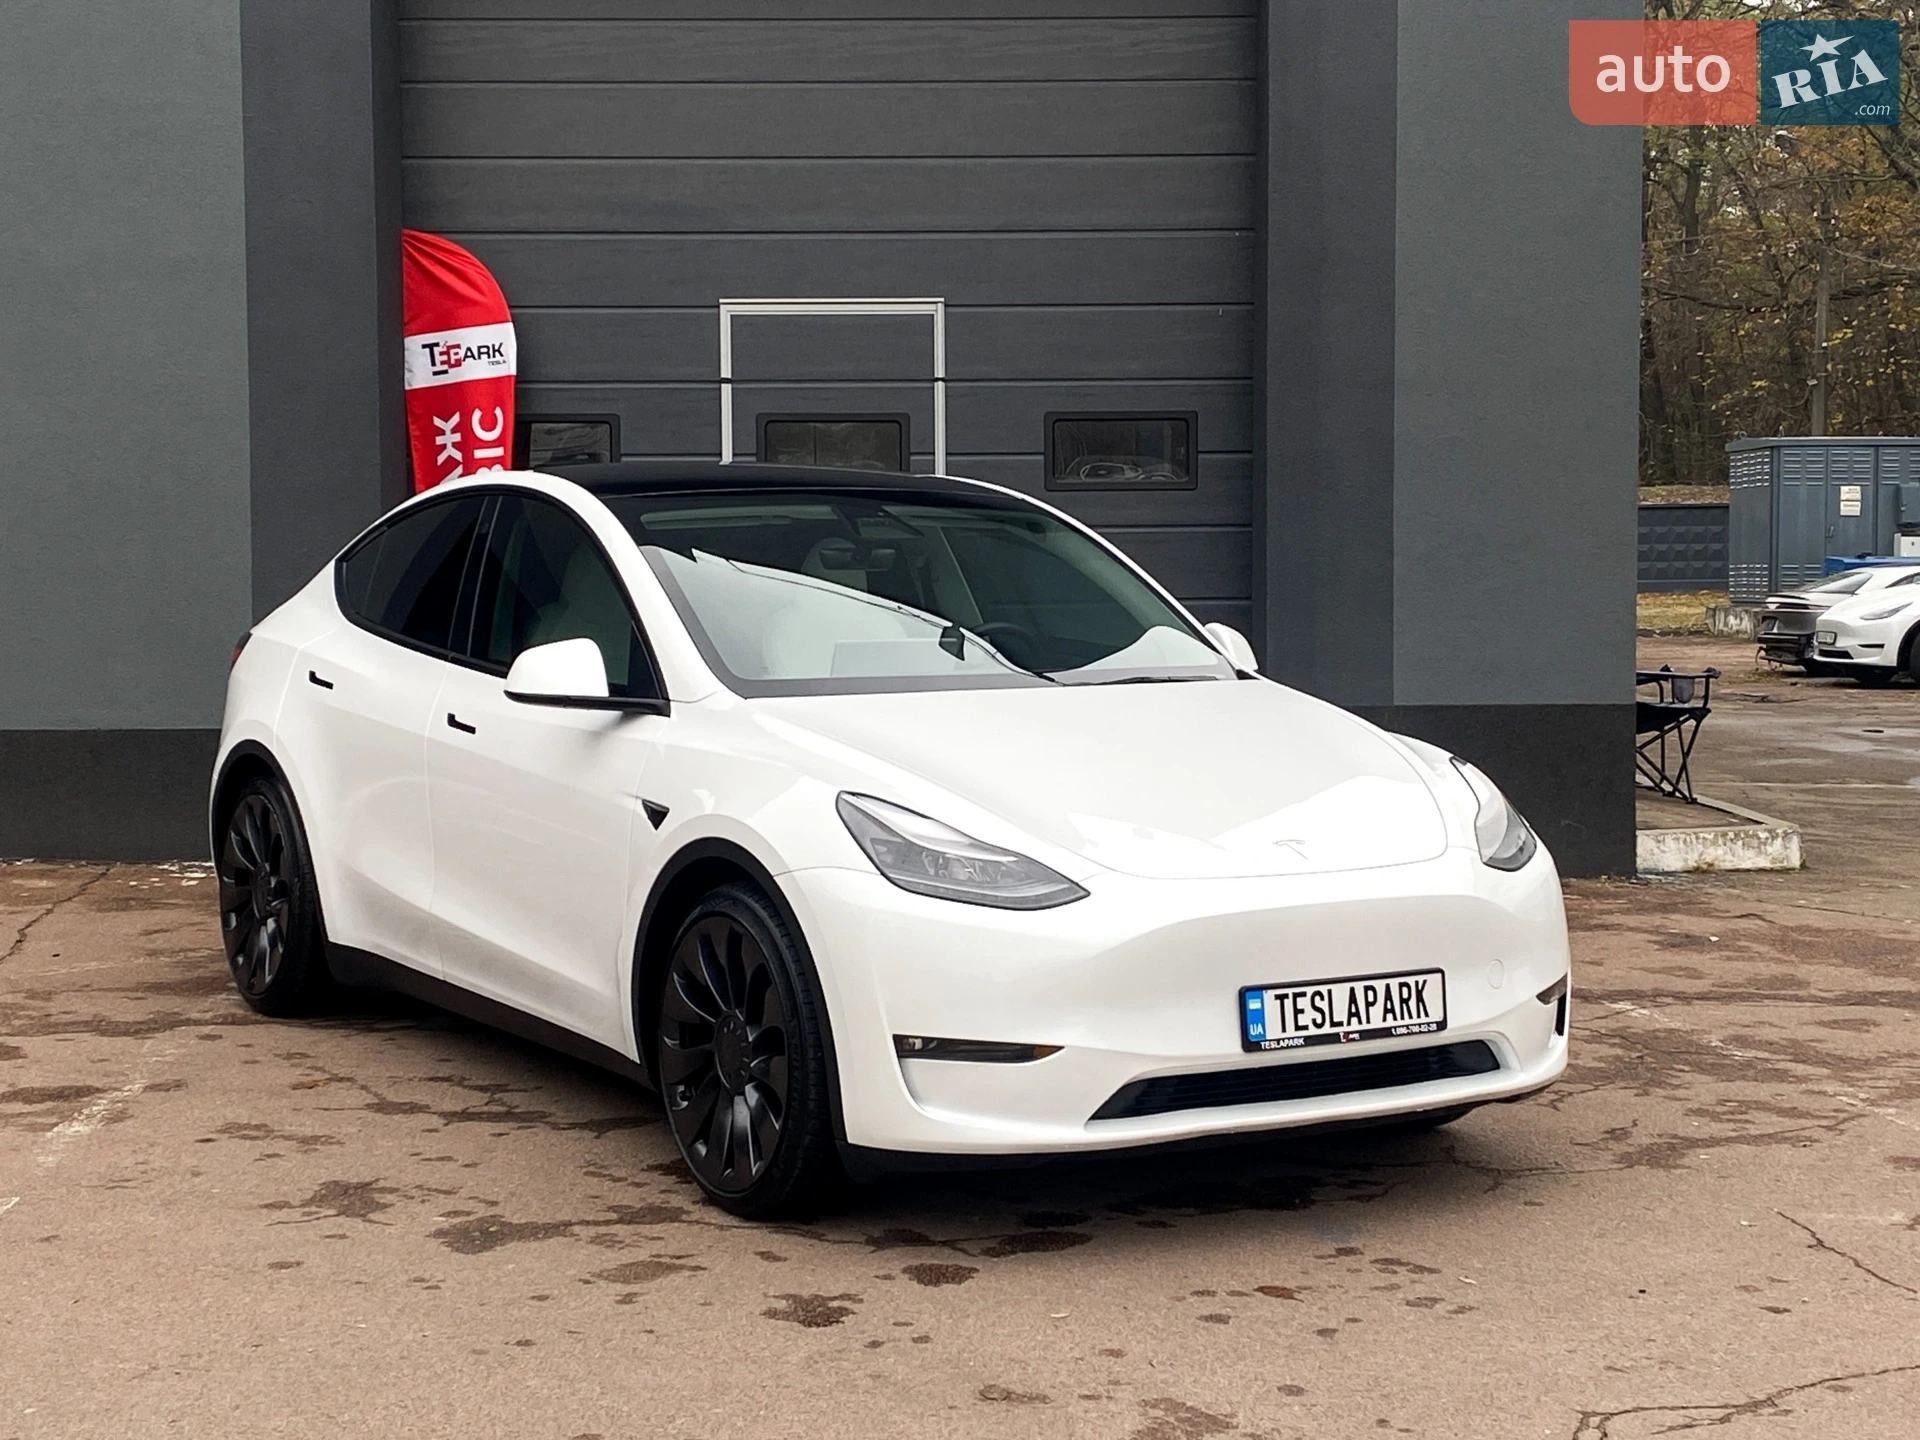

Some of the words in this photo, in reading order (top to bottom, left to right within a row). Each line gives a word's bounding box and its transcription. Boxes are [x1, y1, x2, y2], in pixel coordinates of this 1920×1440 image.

[487, 359, 507, 367] TESLA
[1274, 979, 1430, 1033] TESLAPARK
[1250, 1022, 1264, 1036] UA
[1260, 1037, 1305, 1050] TESLAPARK
